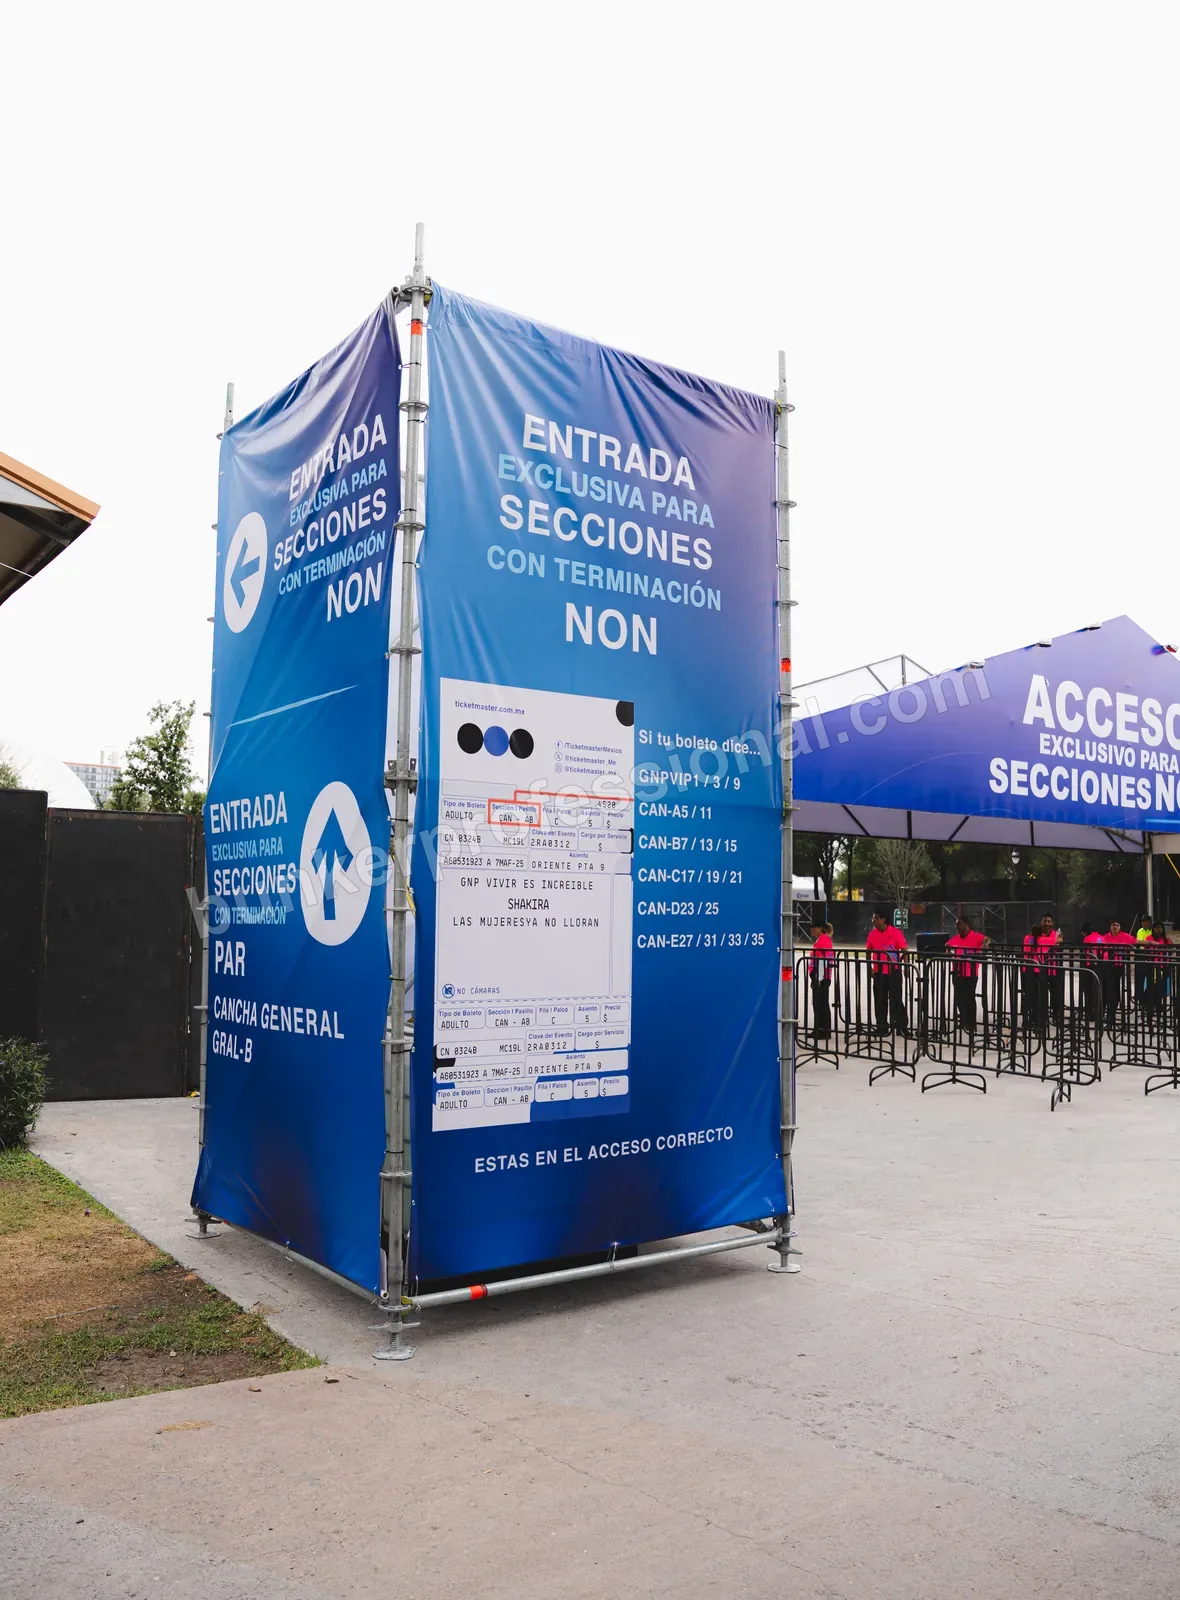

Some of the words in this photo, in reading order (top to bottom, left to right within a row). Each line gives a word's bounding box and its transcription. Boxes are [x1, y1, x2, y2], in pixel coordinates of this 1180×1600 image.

[289, 414, 388, 501] ENTRADA
[523, 413, 696, 490] ENTRADA
[290, 478, 349, 527] EXCLUSIVA
[351, 459, 388, 492] PARA
[498, 453, 645, 512] EXCLUSIVA
[652, 491, 715, 528] PARA
[274, 488, 387, 571] SECCIONES
[500, 494, 712, 570] SECCIONES
[279, 569, 301, 595] CON
[304, 530, 386, 584] TERMINACIÓN
[487, 545, 545, 578] CON
[554, 557, 721, 611] TERMINACIÓN
[327, 562, 382, 622] NON
[566, 602, 657, 655] NON
[455, 700, 525, 715] ticketmaster.com.mx
[564, 743, 622, 754] /TicketmasterMexico
[639, 730, 652, 744] Si
[657, 731, 670, 747] tu
[676, 733, 717, 751] boleto
[722, 739, 761, 755] dice...
[1040, 733, 1136, 768] EXCLUSIVO
[1140, 748, 1179, 774] PARA
[639, 769, 698, 787] GNPVIP1
[704, 774, 709, 788] /
[713, 775, 720, 788] 3
[724, 776, 729, 789] /
[733, 777, 741, 790] 9
[989, 757, 1151, 810] SECCIONES
[1156, 773, 1180, 812] N
[210, 791, 288, 834] ENTRADA
[443, 801, 456, 809] Tipo
[639, 802, 688, 818] CAN-A5
[692, 805, 697, 818] /
[700, 806, 712, 819] 11
[445, 811, 473, 820] ADULTO
[499, 814, 512, 822] CAN
[607, 820, 611, 828] $
[445, 834, 454, 842] CN
[639, 835, 688, 851] CAN-B7
[691, 838, 696, 851] /
[700, 838, 712, 851] 13
[715, 838, 721, 851] /
[724, 839, 737, 852] 15
[212, 840, 258, 861] EXCLUSIVA
[259, 836, 283, 857] PARA
[599, 843, 602, 851] $
[487, 858, 491, 866] A
[532, 861, 571, 870] ORIENTE
[578, 861, 594, 871] PTA
[600, 863, 605, 871] 9
[214, 863, 296, 897] SECCIONES
[638, 868, 695, 883] CAN-C17
[698, 870, 703, 883] /
[707, 870, 720, 883] 19
[722, 870, 727, 883] /
[730, 870, 742, 883] 21
[461, 877, 479, 887] GNP
[487, 878, 516, 888] VIVIR
[524, 879, 535, 889] ES
[542, 879, 593, 890] INCREIBLE
[508, 899, 549, 910] SHAKIRA
[638, 901, 694, 915] CAN-D23
[698, 902, 702, 915] /
[705, 902, 719, 915] 25
[215, 906, 230, 924] CON
[230, 901, 286, 925] TERMINACIÓN
[453, 917, 472, 926] LAS
[480, 917, 538, 927] MUJERESYA
[545, 918, 557, 927] NO
[564, 918, 599, 927] LLORAN
[637, 933, 693, 948] CAN-E27
[696, 934, 701, 947] /
[705, 934, 717, 947] 31
[721, 933, 726, 946] /
[728, 933, 741, 946] 33
[744, 933, 749, 946] /
[752, 933, 764, 946] 35
[215, 941, 245, 976] PAR
[470, 986, 500, 994] CÁMARAS
[214, 995, 258, 1027] CANCHA
[260, 1003, 345, 1039] GENERAL
[441, 1020, 469, 1029] ADULTO
[585, 1015, 589, 1023] 5
[603, 1014, 607, 1022] $
[212, 1029, 252, 1063] GRAL-B
[440, 1047, 450, 1056] CN
[500, 1044, 521, 1052] MC19L
[527, 1042, 567, 1051] 2RA0312
[595, 1041, 599, 1049] $
[483, 1069, 487, 1077] A
[492, 1068, 521, 1076] 7MAF-25
[528, 1064, 568, 1074] ORIENTE
[575, 1063, 591, 1071] PTA
[520, 1095, 528, 1103] AB
[602, 1088, 606, 1097] $
[440, 1101, 467, 1110] ADULTO
[475, 1153, 529, 1173] ESTAS
[535, 1149, 557, 1166] EN
[564, 1147, 583, 1162] EL
[588, 1138, 650, 1160] ACCESO
[656, 1126, 733, 1150] CORRECTO
